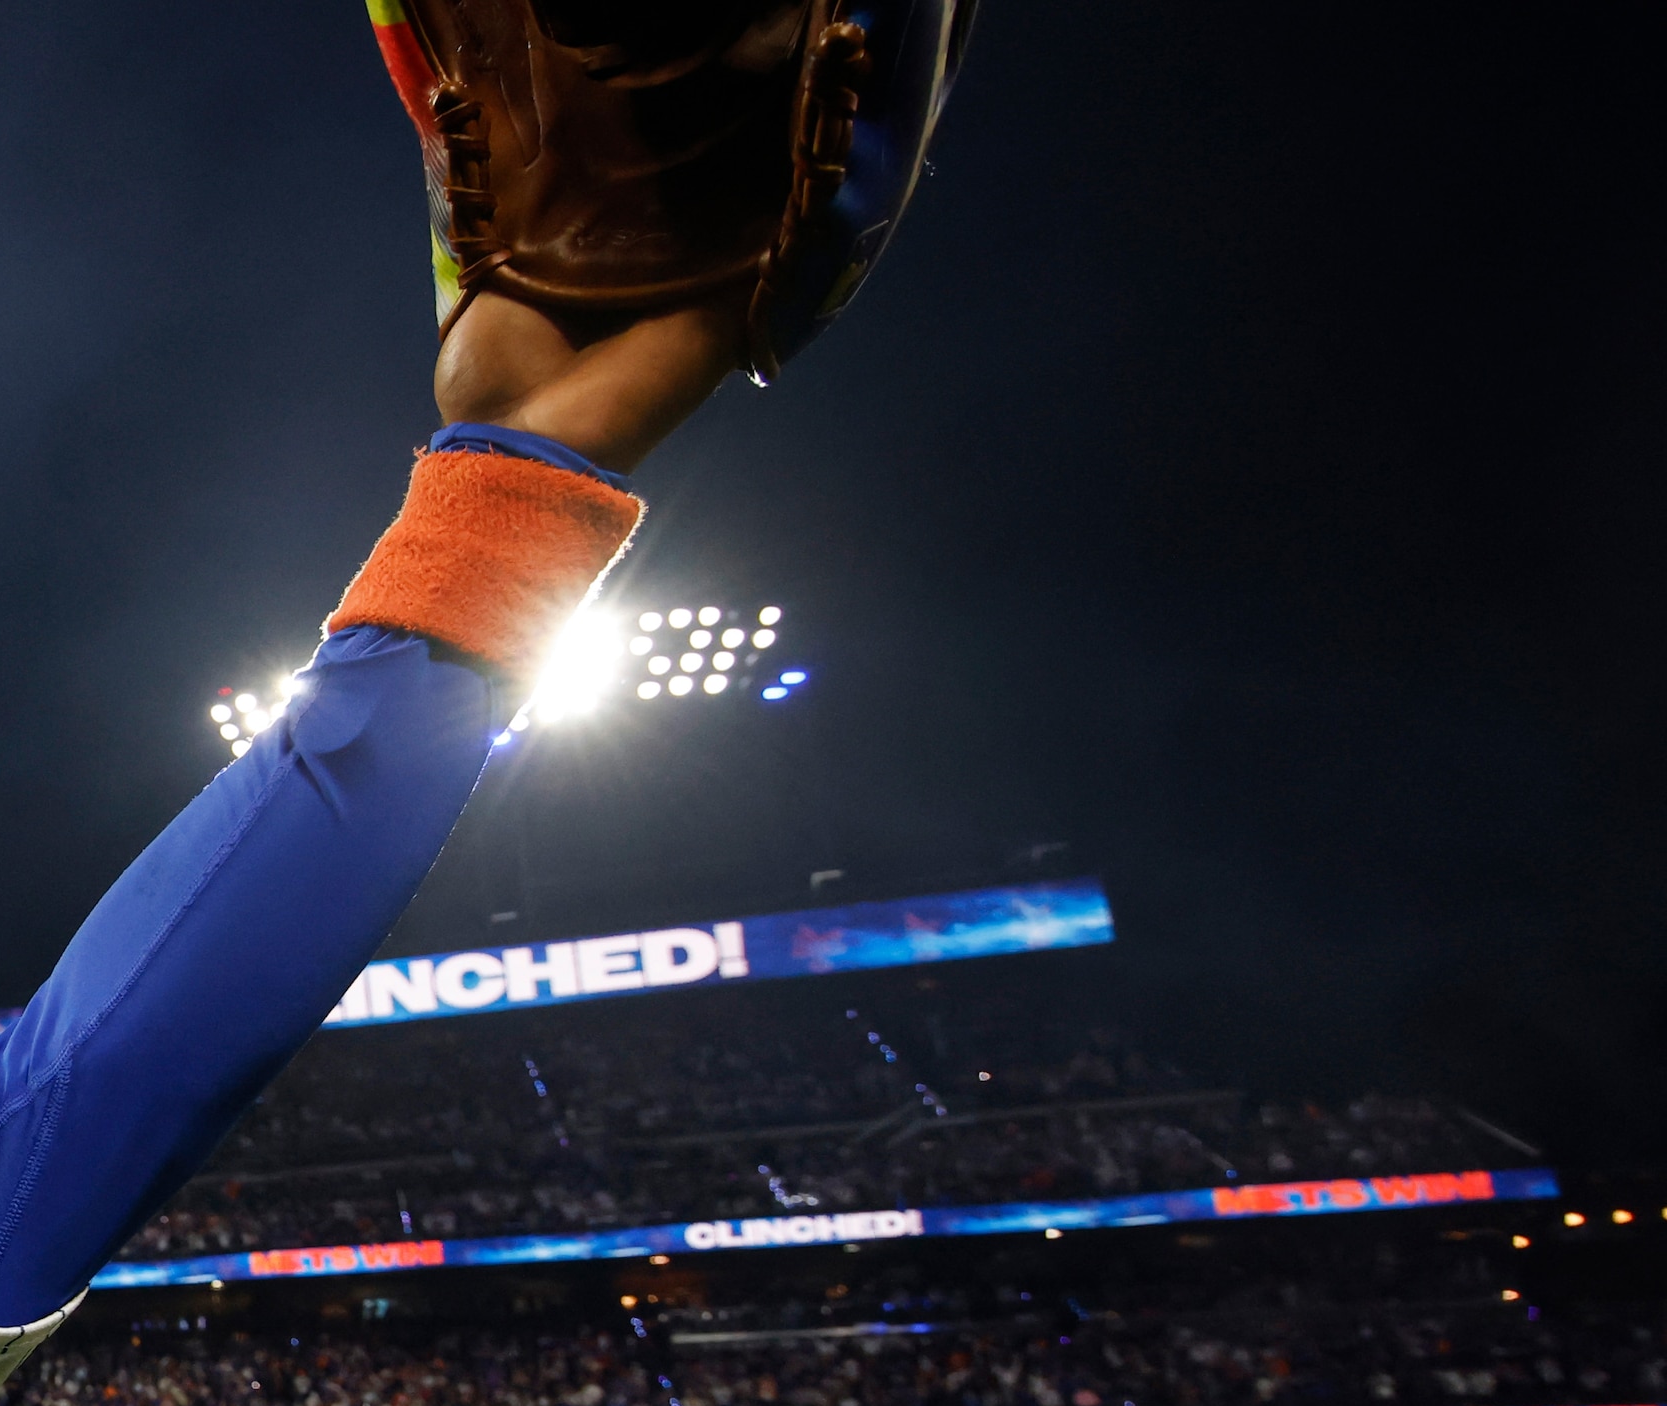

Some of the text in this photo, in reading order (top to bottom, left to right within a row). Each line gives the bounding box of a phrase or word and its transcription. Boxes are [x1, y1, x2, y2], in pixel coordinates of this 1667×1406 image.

[322, 921, 751, 1023] INCHED!
[1212, 1179, 1370, 1214] METS
[684, 1209, 924, 1249] CLINCHED!
[249, 1245, 358, 1276] METS
